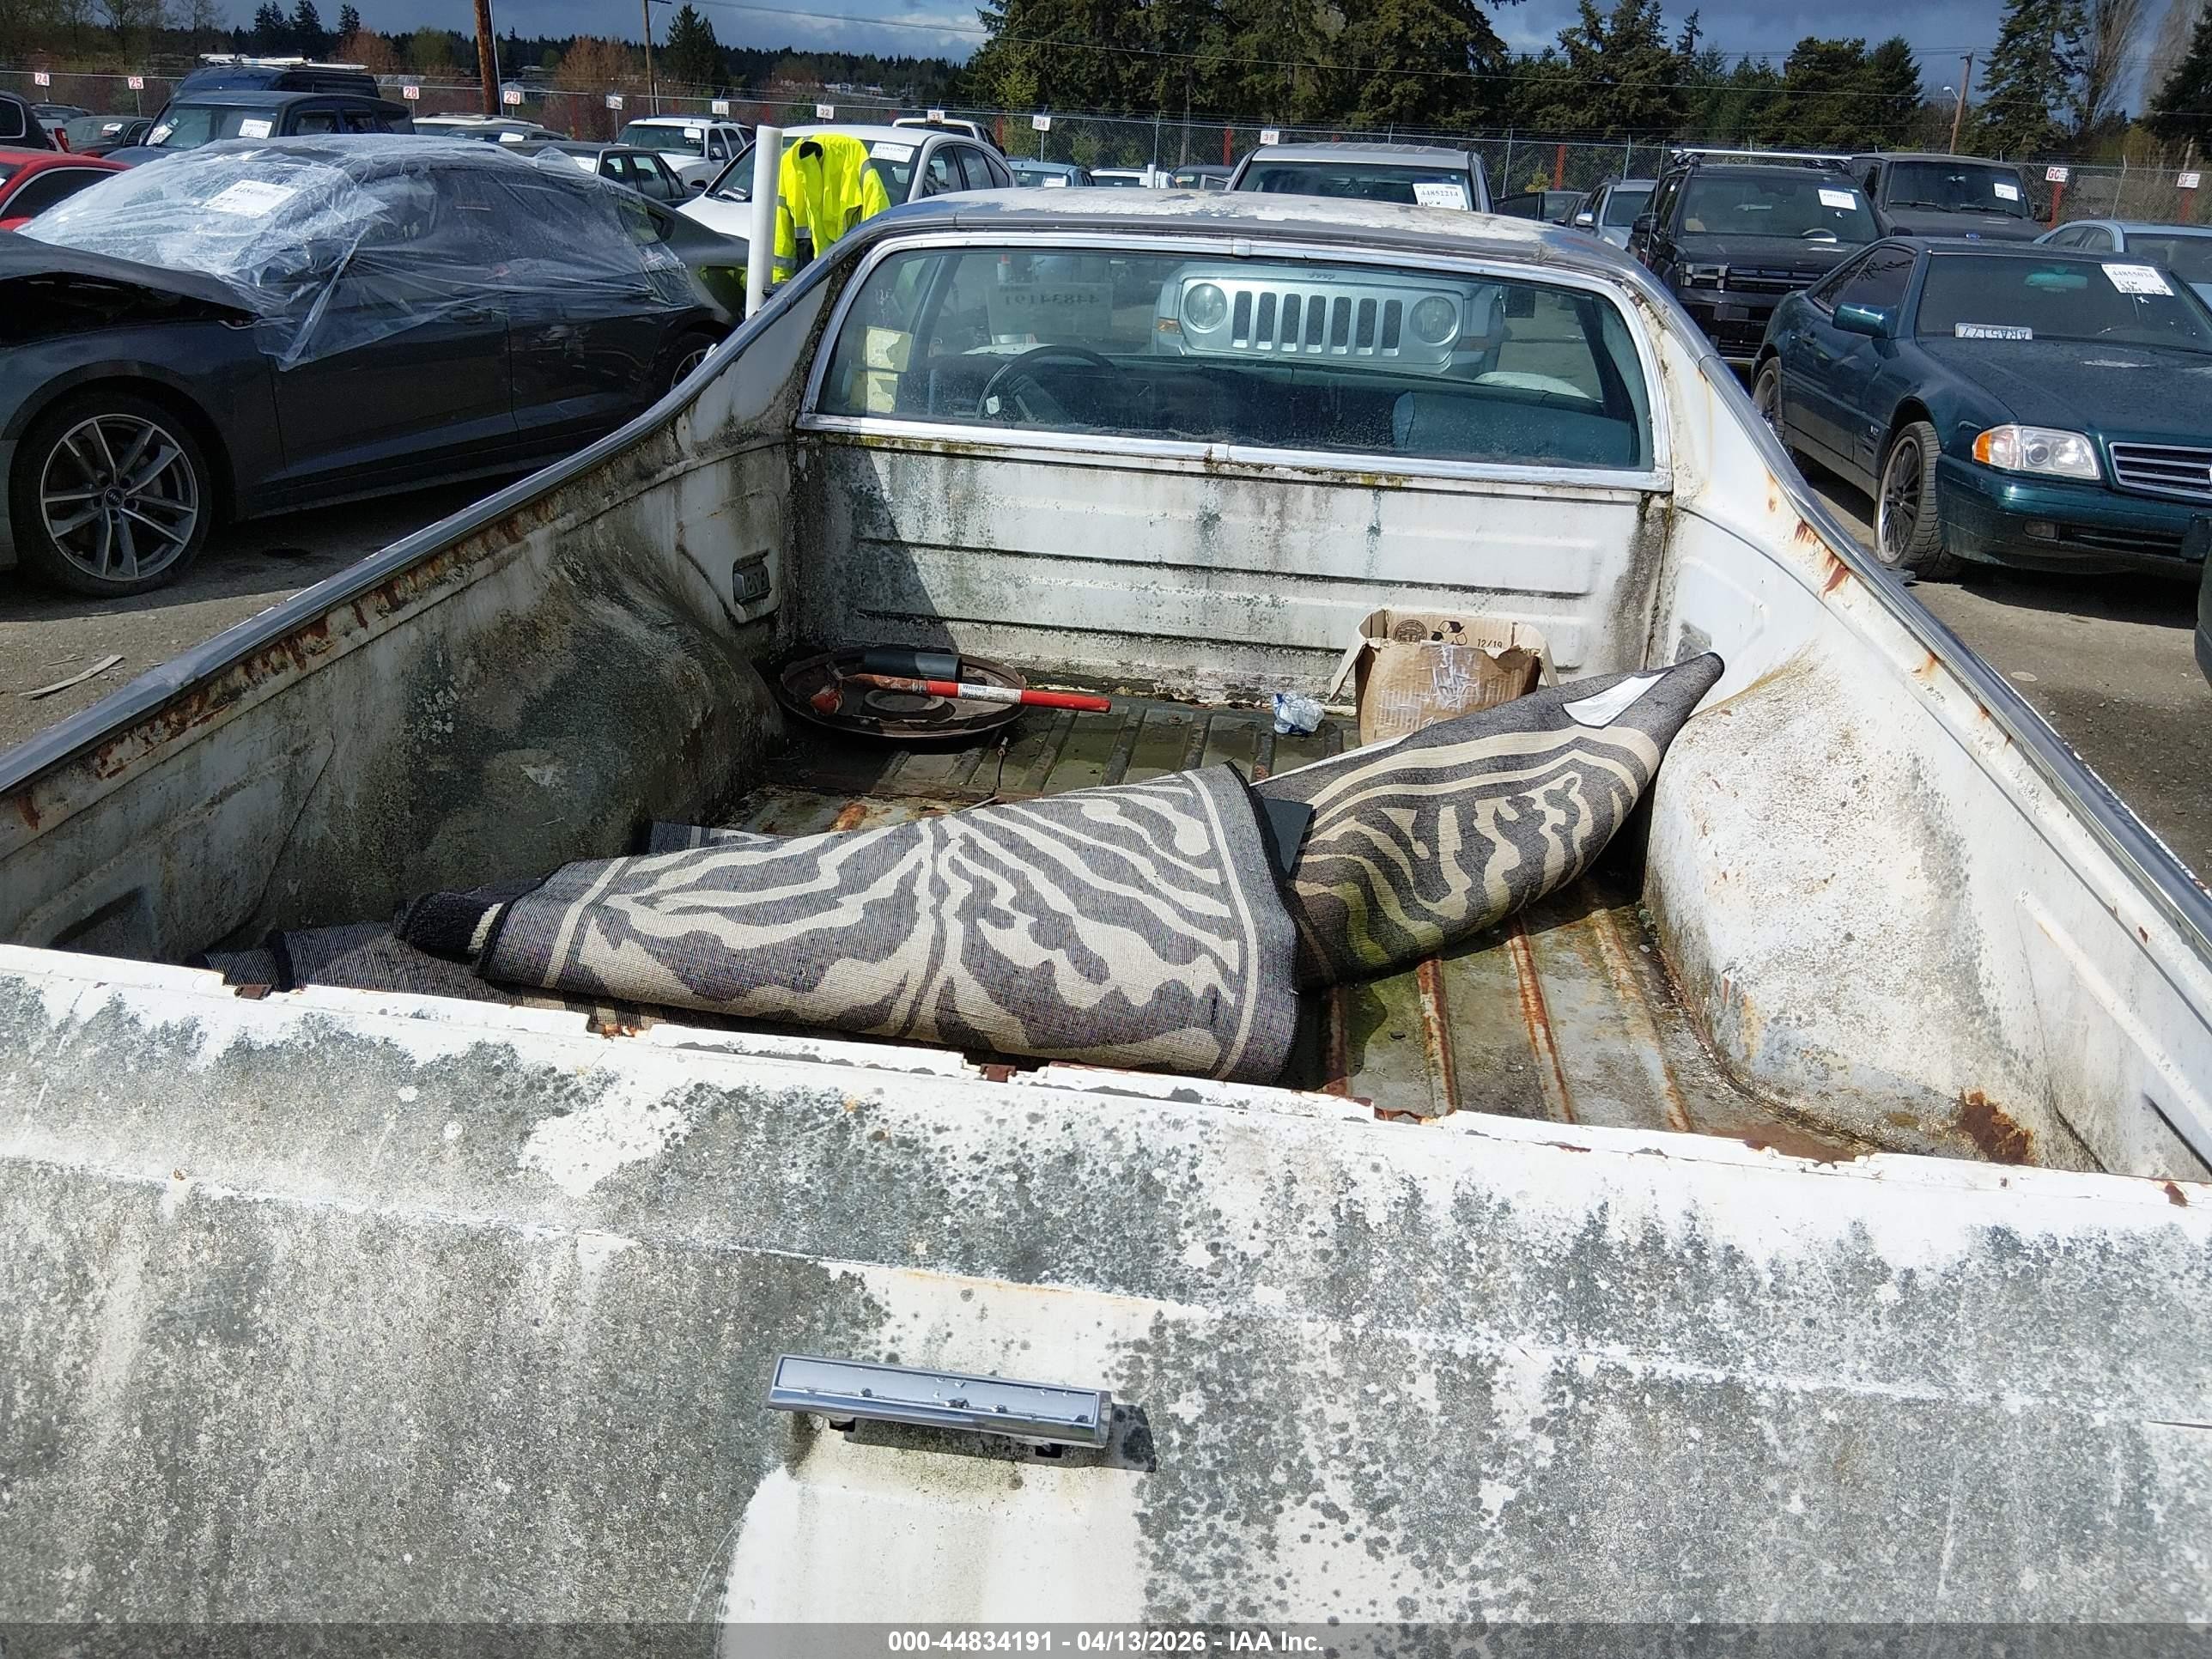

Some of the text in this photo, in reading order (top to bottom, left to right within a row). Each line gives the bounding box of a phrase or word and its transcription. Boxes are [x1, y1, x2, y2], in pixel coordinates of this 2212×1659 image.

[37, 75, 49, 84] 24
[129, 77, 143, 88] 25
[404, 87, 418, 99] 28
[506, 92, 519, 104] 29
[2048, 168, 2061, 179] GC
[2179, 174, 2191, 186] SF
[1477, 638, 1503, 649] 12/19
